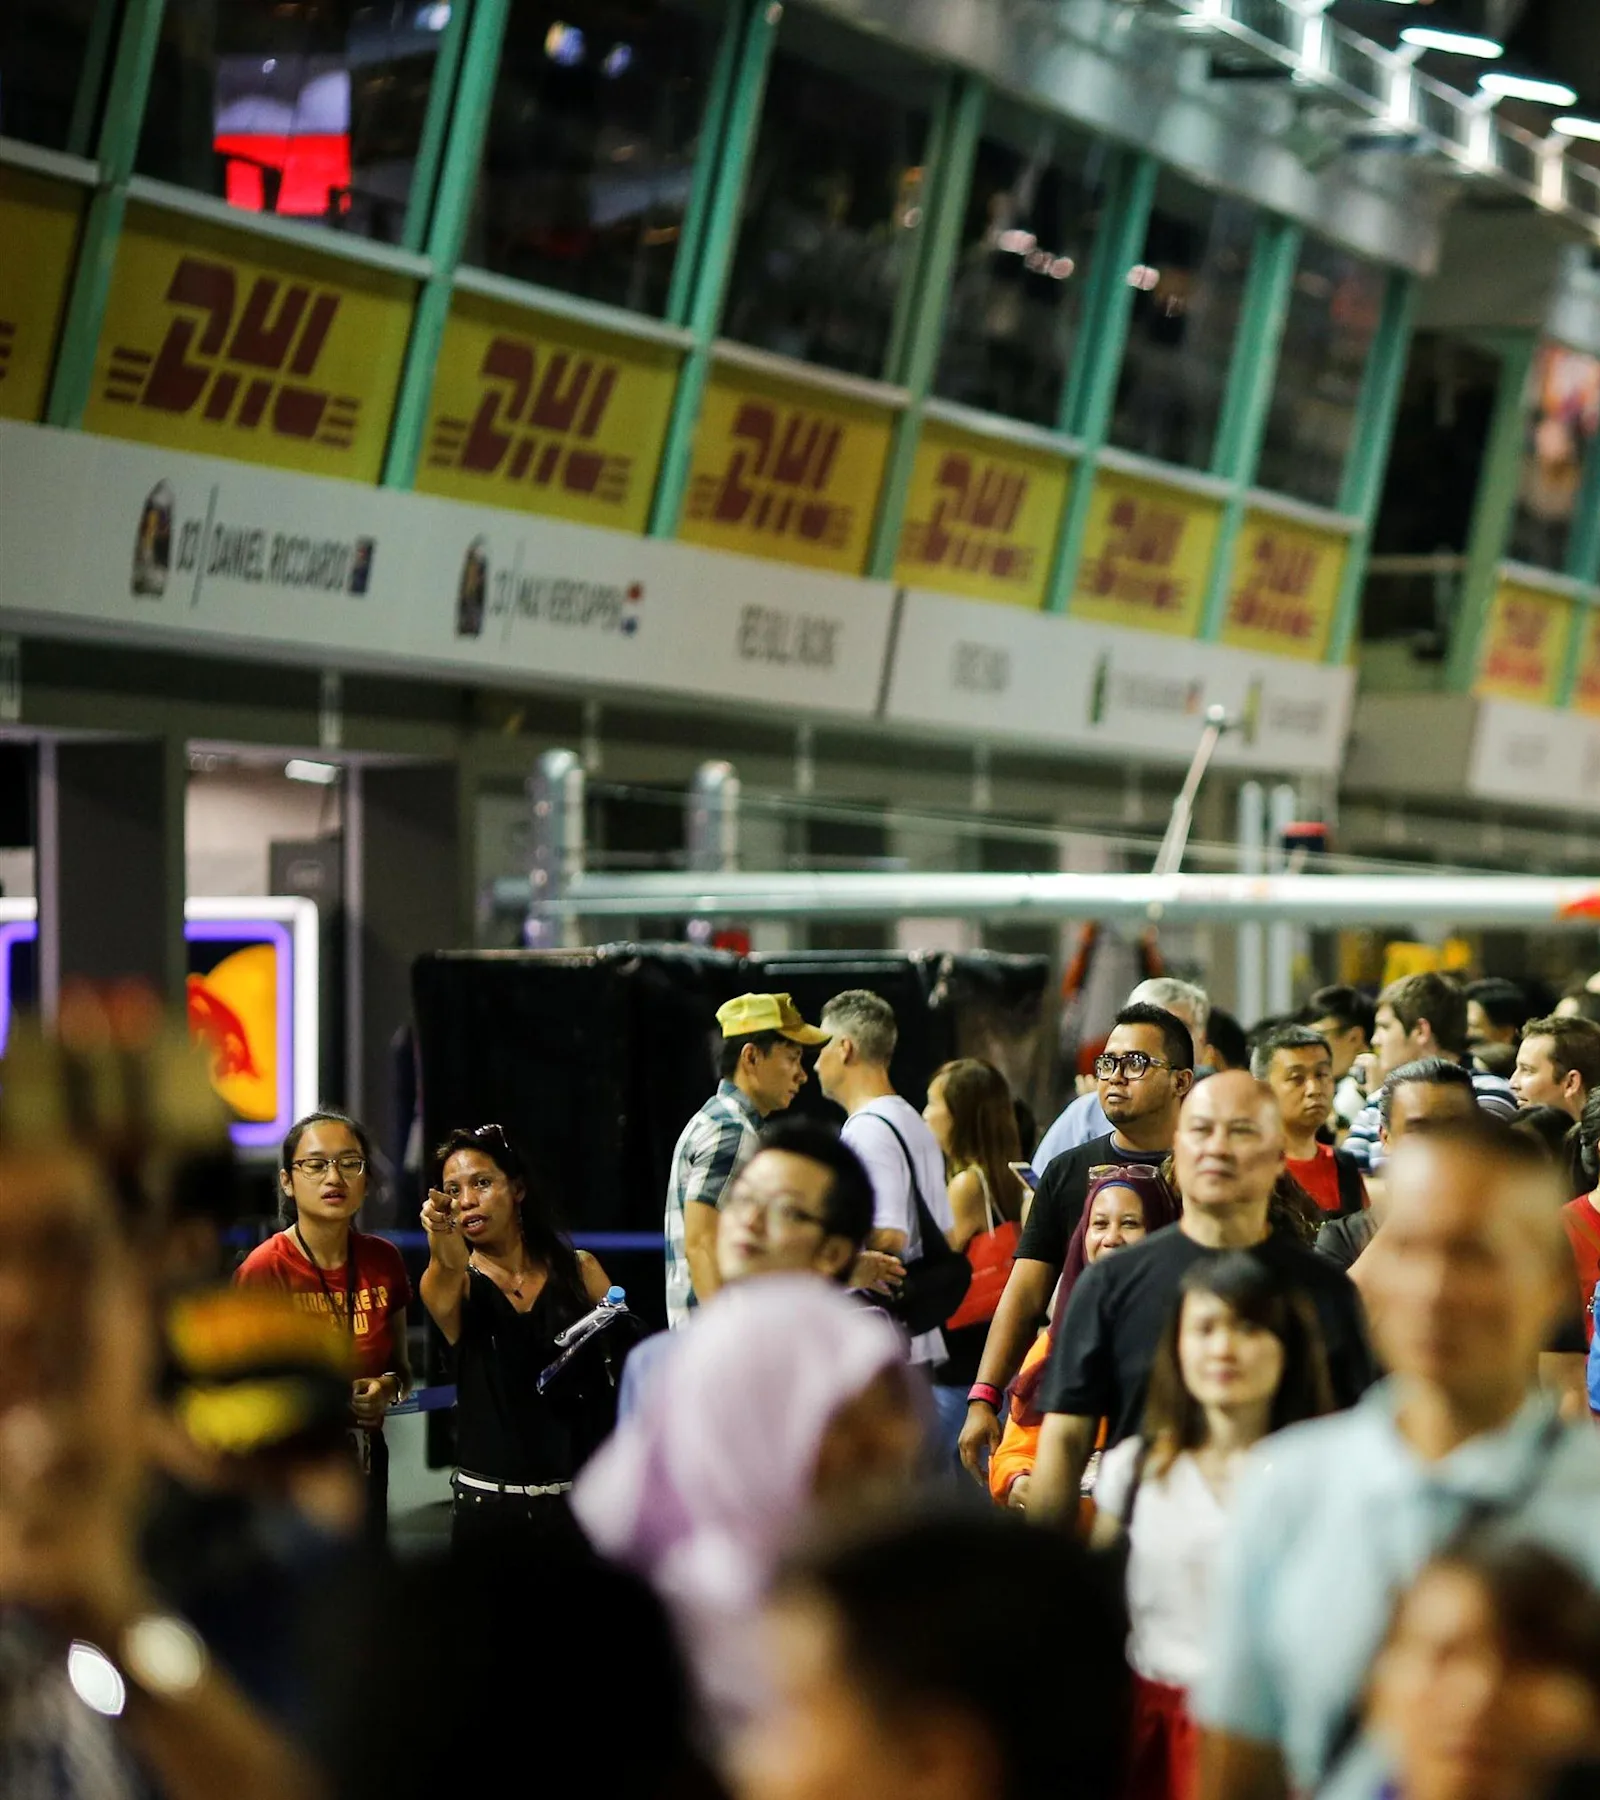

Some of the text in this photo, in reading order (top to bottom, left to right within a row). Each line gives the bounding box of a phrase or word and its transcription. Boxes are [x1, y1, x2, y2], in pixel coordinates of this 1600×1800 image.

[139, 256, 343, 442] DHL
[459, 335, 619, 494] DHL
[713, 401, 844, 541] DHL
[293, 1289, 372, 1313] SINGPRE
